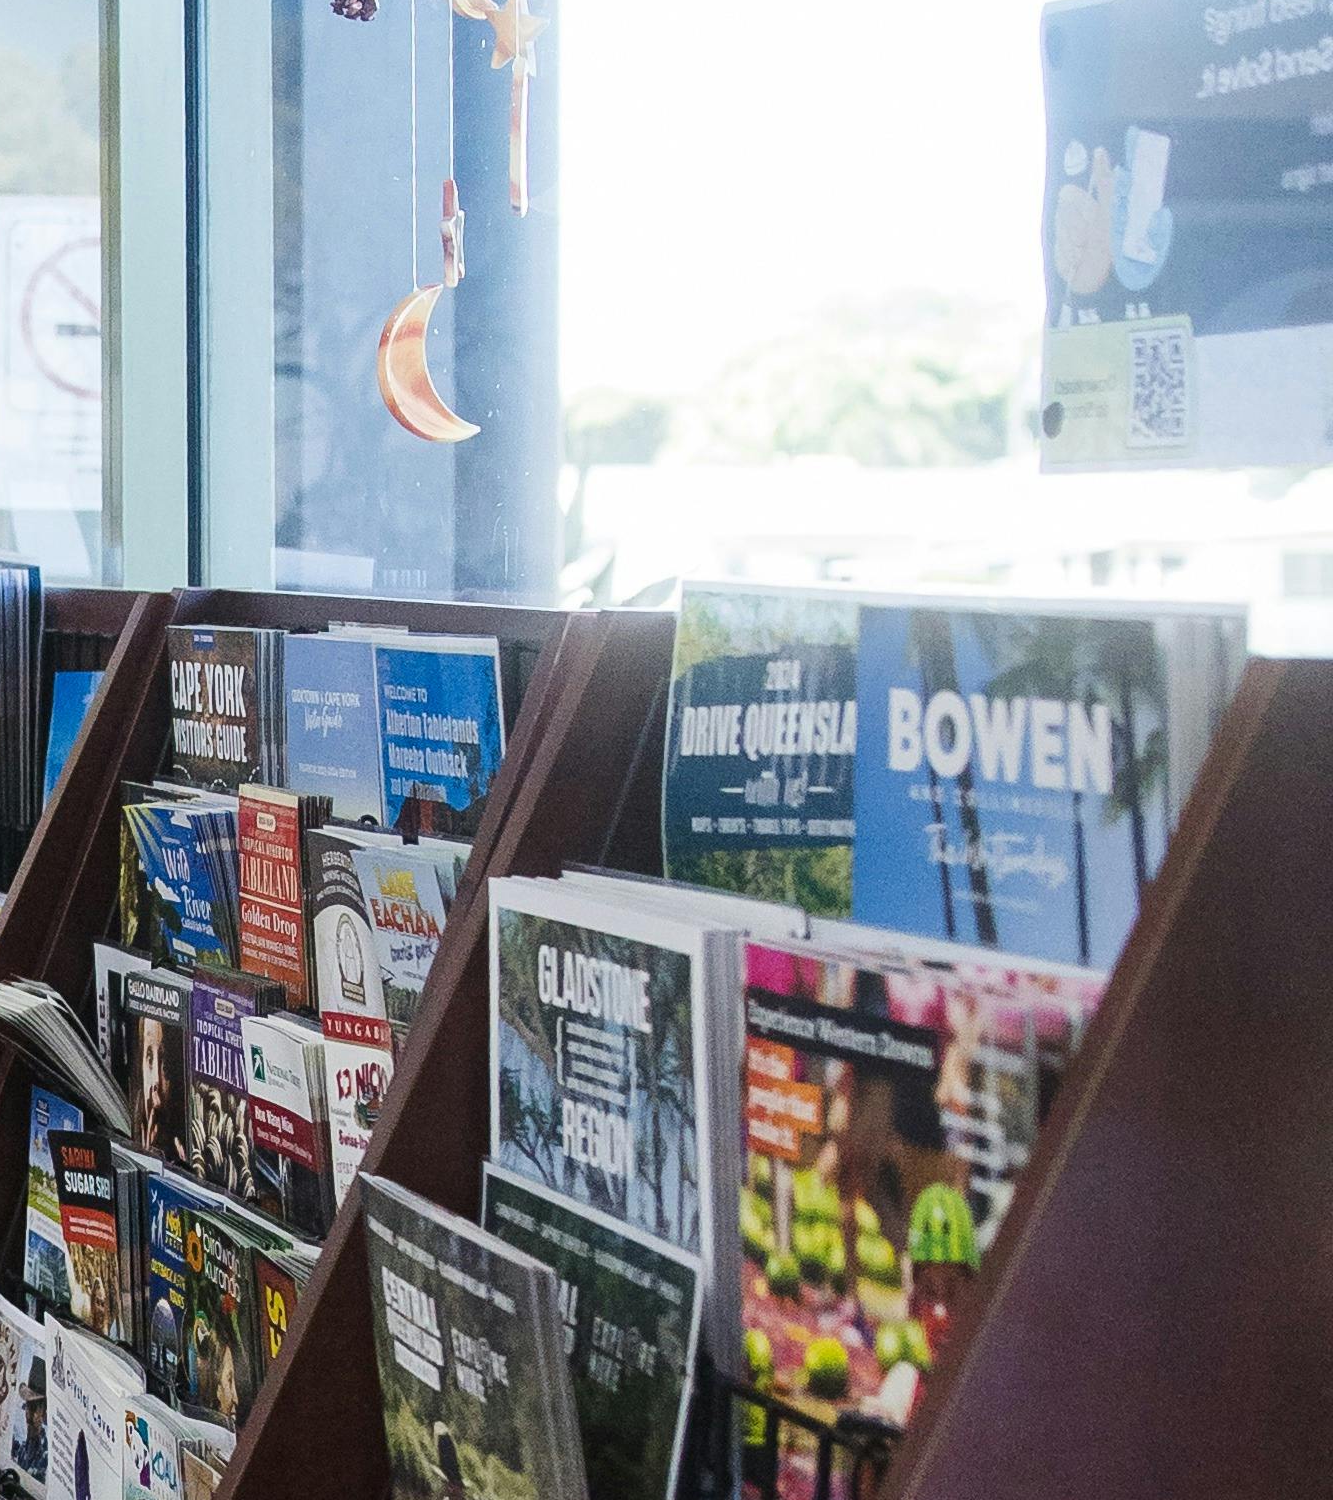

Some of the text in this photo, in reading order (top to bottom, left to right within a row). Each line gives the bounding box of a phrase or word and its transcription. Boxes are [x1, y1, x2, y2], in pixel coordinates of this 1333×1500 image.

[171, 660, 246, 718] CAPE YORK
[173, 717, 247, 763] VISITORS GUIDE
[423, 711, 480, 745] Tablelands
[681, 705, 742, 757] DRIVE
[887, 688, 1114, 796] BOWEN
[426, 748, 468, 779] Outback
[239, 854, 298, 903] TABLELAND
[181, 884, 212, 921] River
[241, 903, 298, 941] Golden Drop
[537, 944, 654, 1034] GLADSTONE
[560, 1098, 633, 1176] REGION
[64, 1171, 95, 1195] SUGAR
[91, 1404, 116, 1444] Caves
